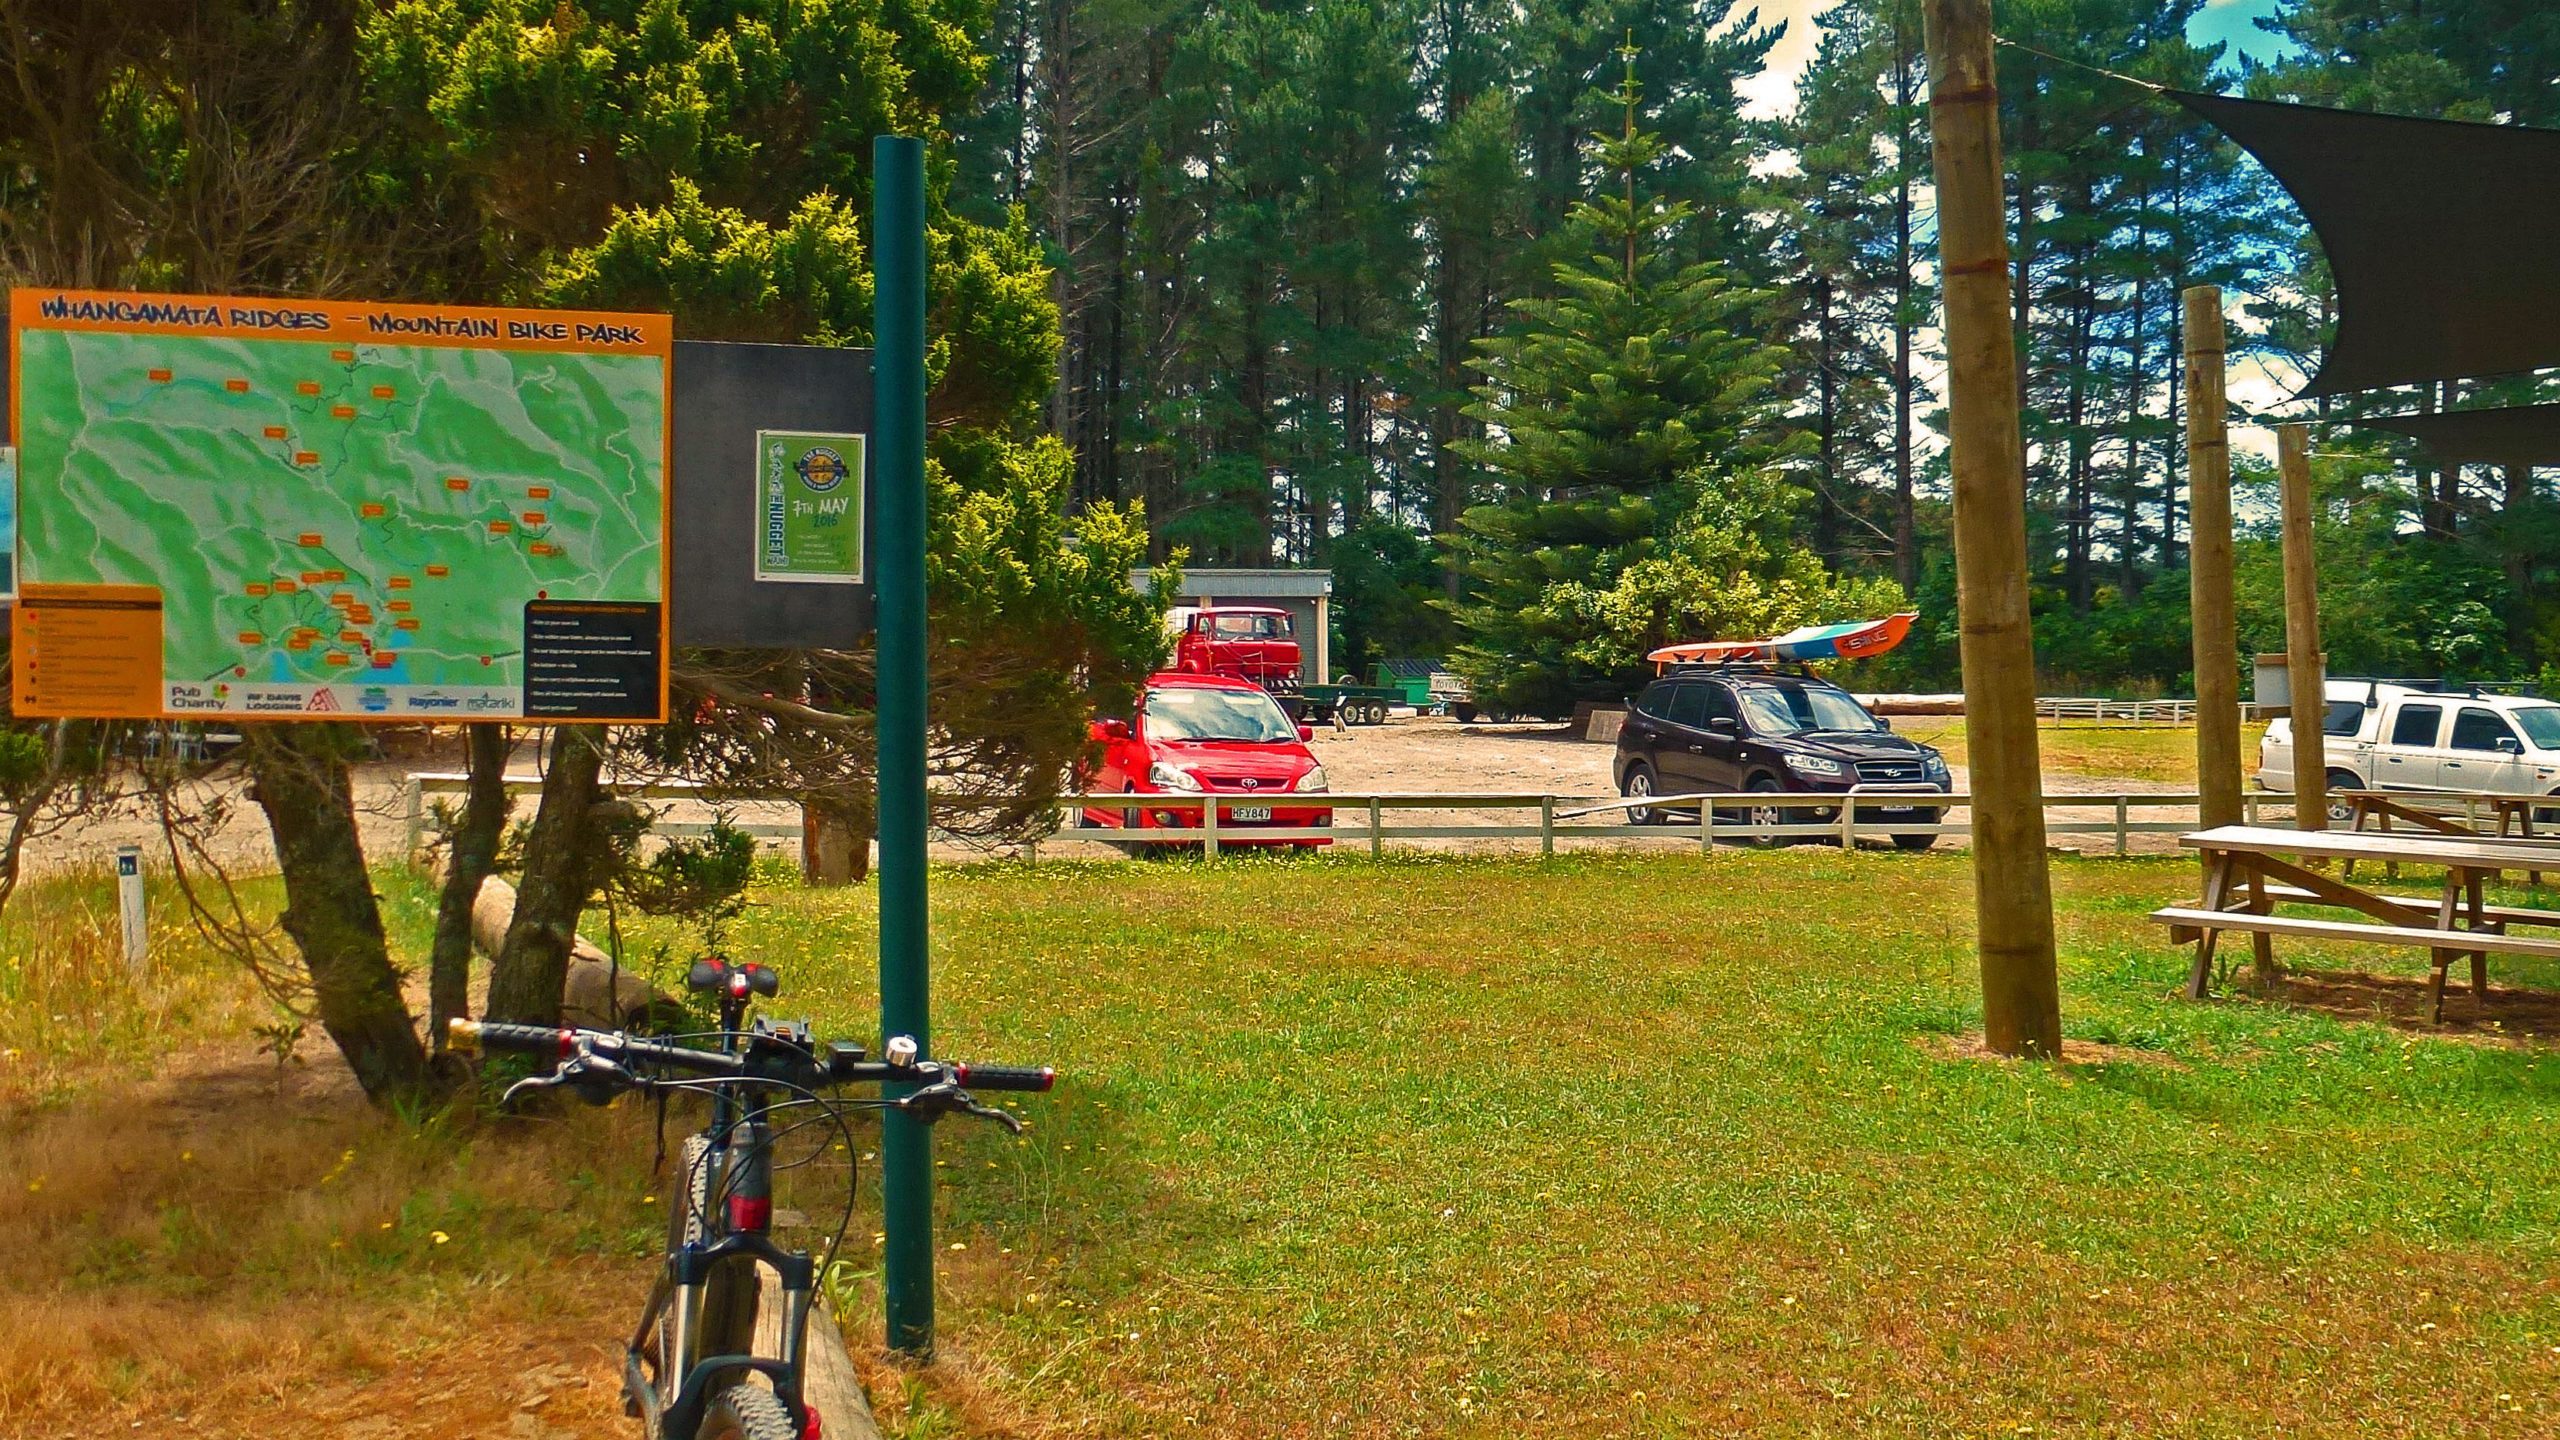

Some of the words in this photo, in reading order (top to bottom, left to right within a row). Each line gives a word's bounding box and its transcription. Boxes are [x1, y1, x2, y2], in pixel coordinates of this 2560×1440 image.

[42, 296, 222, 327] WHANGAMATA
[230, 309, 330, 330] RIDGES
[367, 312, 498, 338] MOUNTAIN
[509, 321, 568, 339] BIKE
[576, 324, 646, 344] PARK
[819, 497, 848, 514] MAY
[814, 514, 837, 527] 2016
[769, 503, 784, 556] NUGGET
[1435, 680, 1464, 690] TOYOTA
[172, 687, 200, 697] Pub
[266, 693, 302, 701] DAVIS
[172, 698, 226, 711] Charity
[409, 697, 459, 709] Rayonier
[1232, 808, 1270, 818] HFY847
